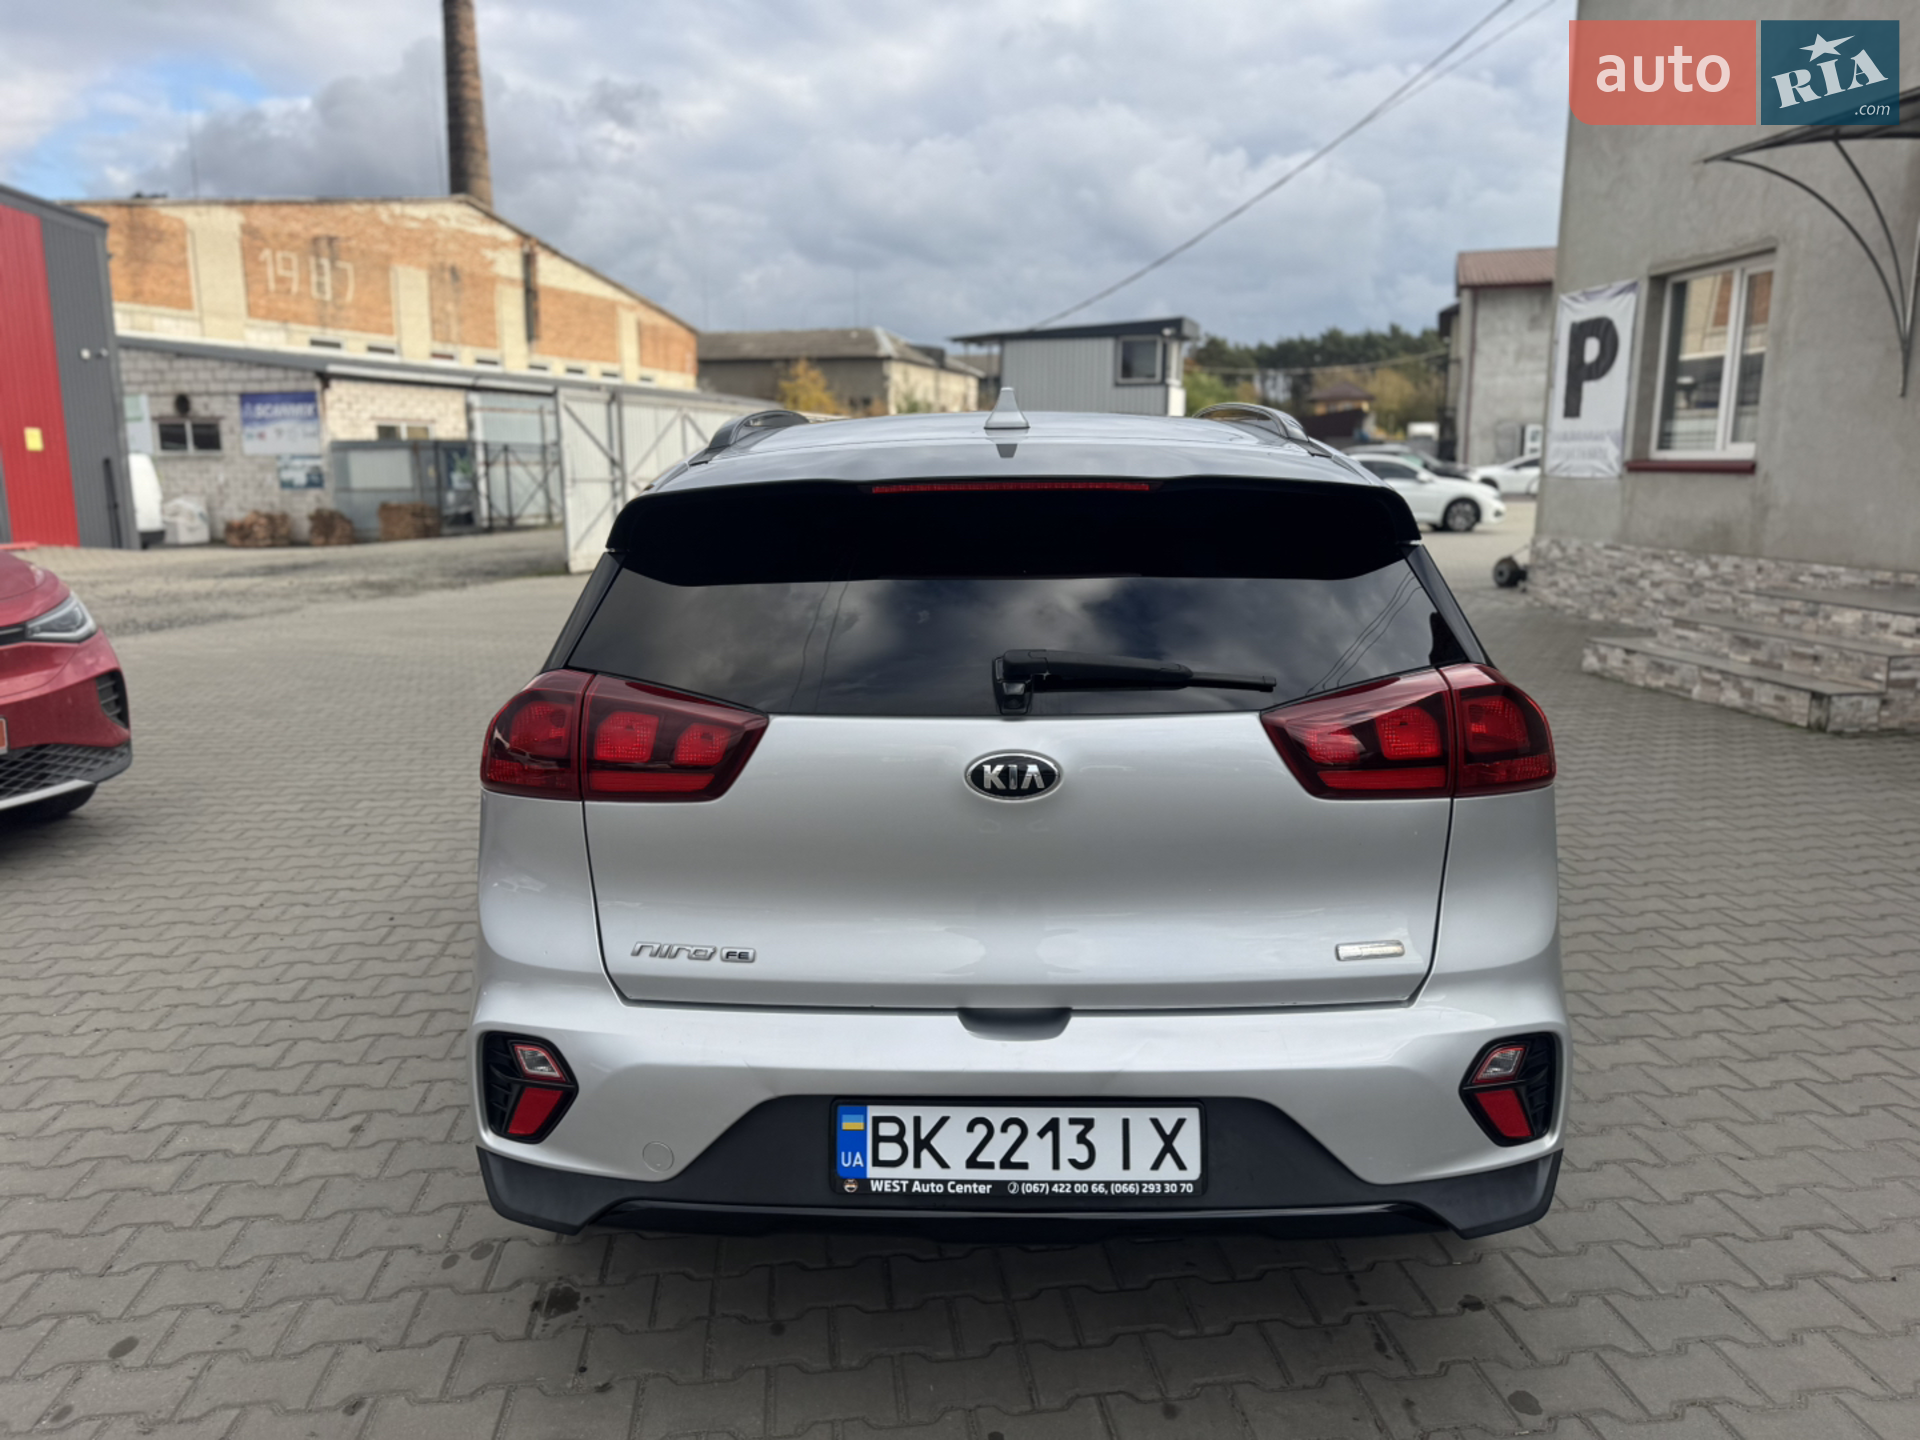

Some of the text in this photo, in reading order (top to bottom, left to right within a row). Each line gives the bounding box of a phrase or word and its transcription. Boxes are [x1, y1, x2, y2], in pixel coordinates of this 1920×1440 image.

[1563, 316, 1620, 418] P
[981, 764, 1046, 790] KIA
[871, 1115, 951, 1169] BK
[965, 1116, 1097, 1170] 2213
[841, 1151, 864, 1167] UA
[870, 1180, 1193, 1195] WEST Auto Center (067) 422 00 66, (066) 293 30 70
